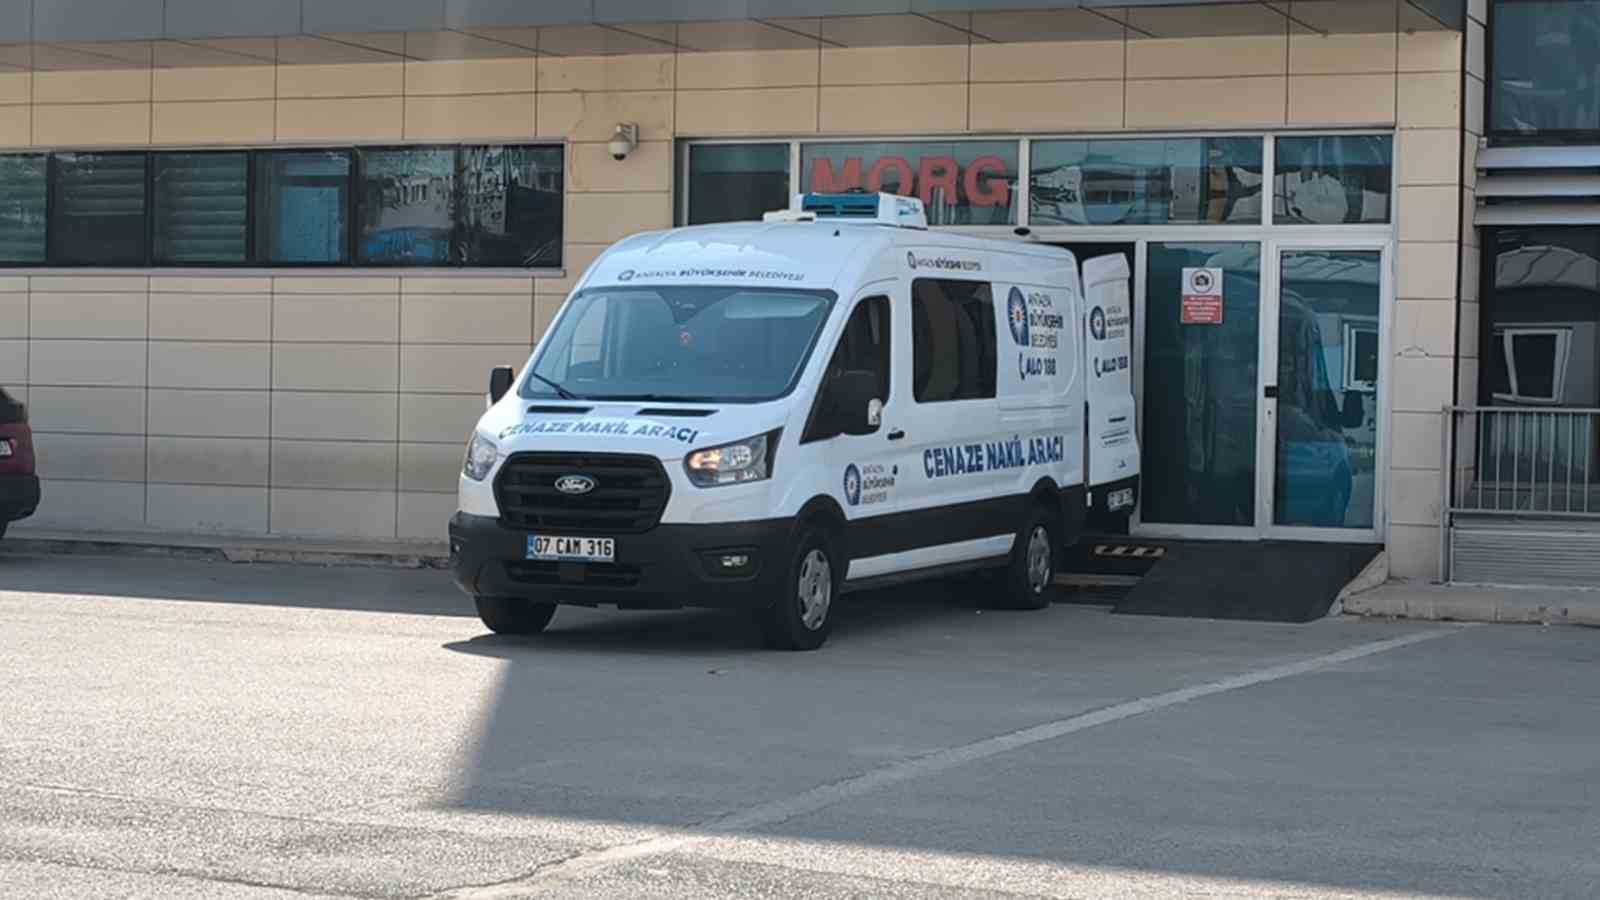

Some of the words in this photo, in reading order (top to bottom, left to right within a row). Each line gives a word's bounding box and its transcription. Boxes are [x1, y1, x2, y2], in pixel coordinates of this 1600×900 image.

[811, 155, 1009, 207] MORG
[1026, 357, 1042, 376] ALO
[498, 421, 569, 440] CENAZE
[570, 420, 630, 435] NAKİL
[632, 424, 699, 444] ARACI
[923, 444, 984, 479] CENAZE
[984, 434, 1025, 471] NAKİL
[1027, 435, 1064, 466] ARACI
[534, 537, 551, 553] 07
[556, 538, 581, 555] CAM
[586, 539, 612, 556] 316
